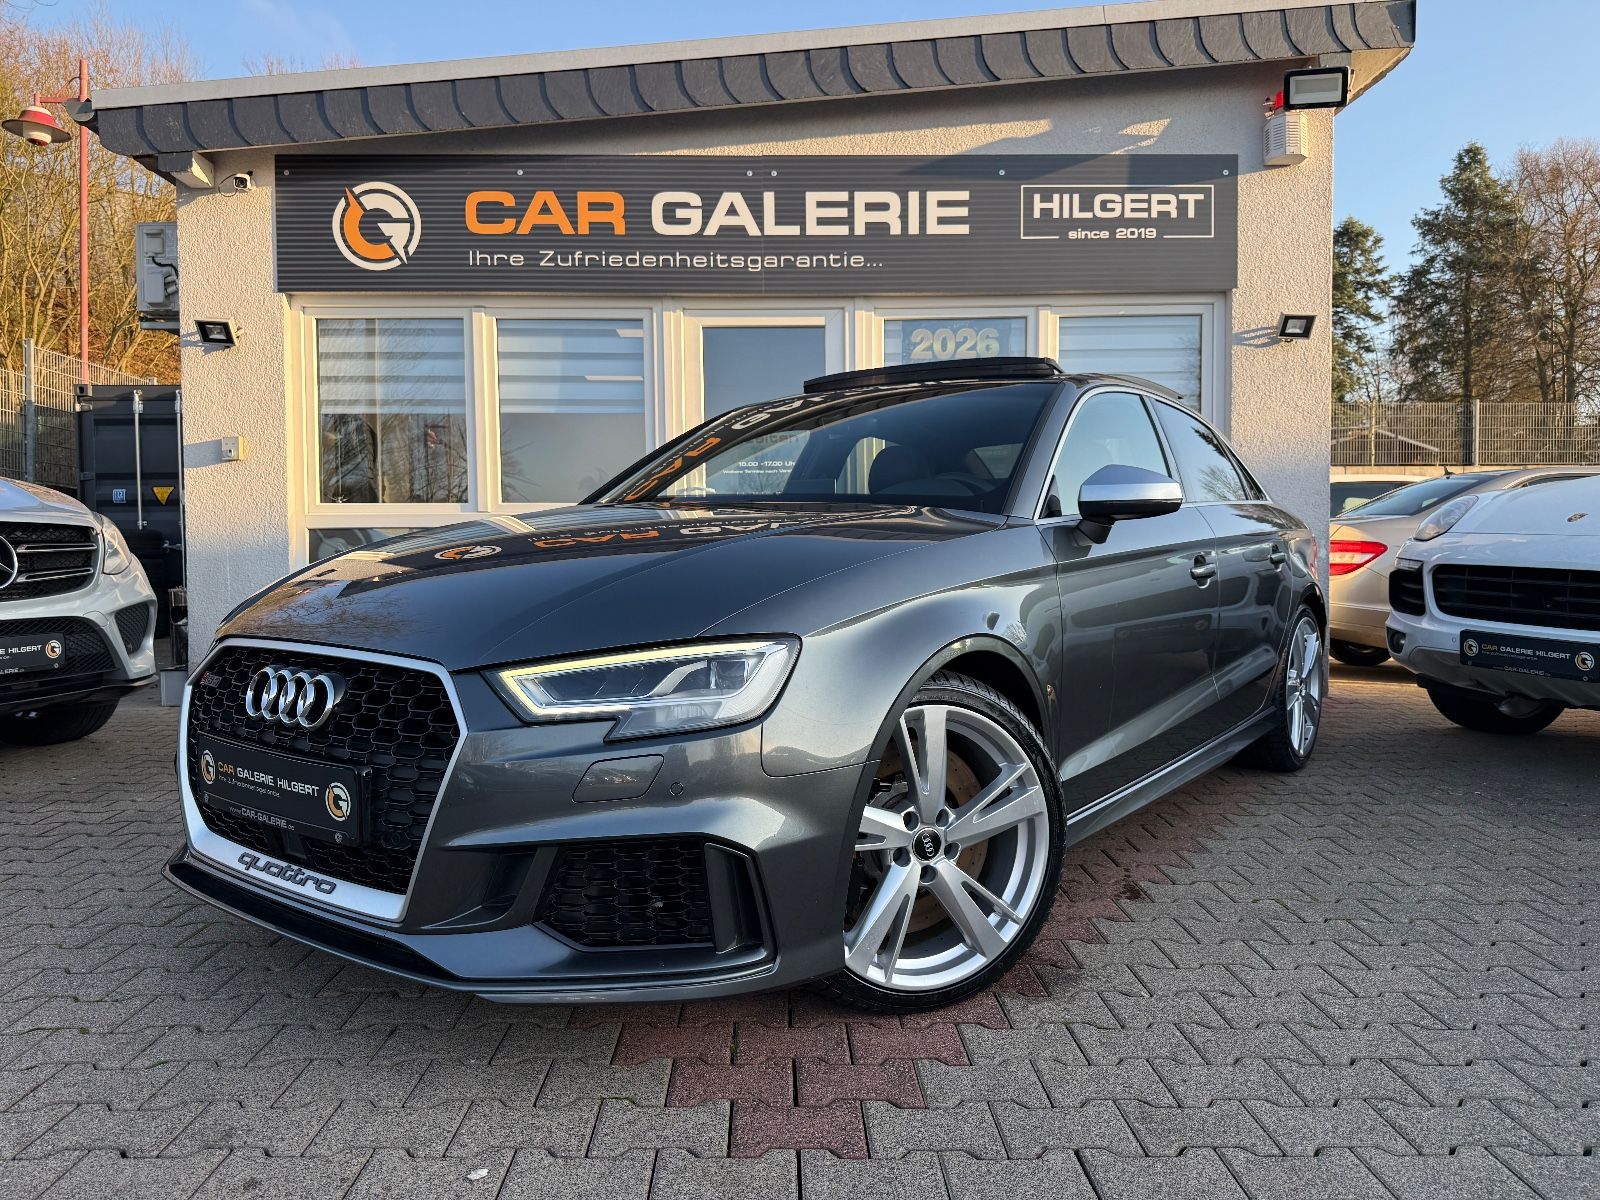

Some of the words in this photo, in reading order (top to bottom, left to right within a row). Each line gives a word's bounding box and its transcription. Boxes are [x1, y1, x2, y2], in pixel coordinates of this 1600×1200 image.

[464, 190, 626, 236] CAR
[650, 190, 971, 236] GALERIE
[1032, 192, 1206, 220] HILGERT
[1067, 227, 1111, 240] since
[1114, 227, 1158, 240] 2019
[468, 250, 526, 268] Ihre
[538, 250, 884, 272] Zufriedenheitsgarantie...
[910, 327, 1000, 360] 2026
[8, 645, 42, 653] HILGERT
[217, 761, 235, 775] CAR
[236, 767, 275, 787] GALERIE
[277, 777, 320, 797] HILGERT
[237, 851, 337, 895] quattro
